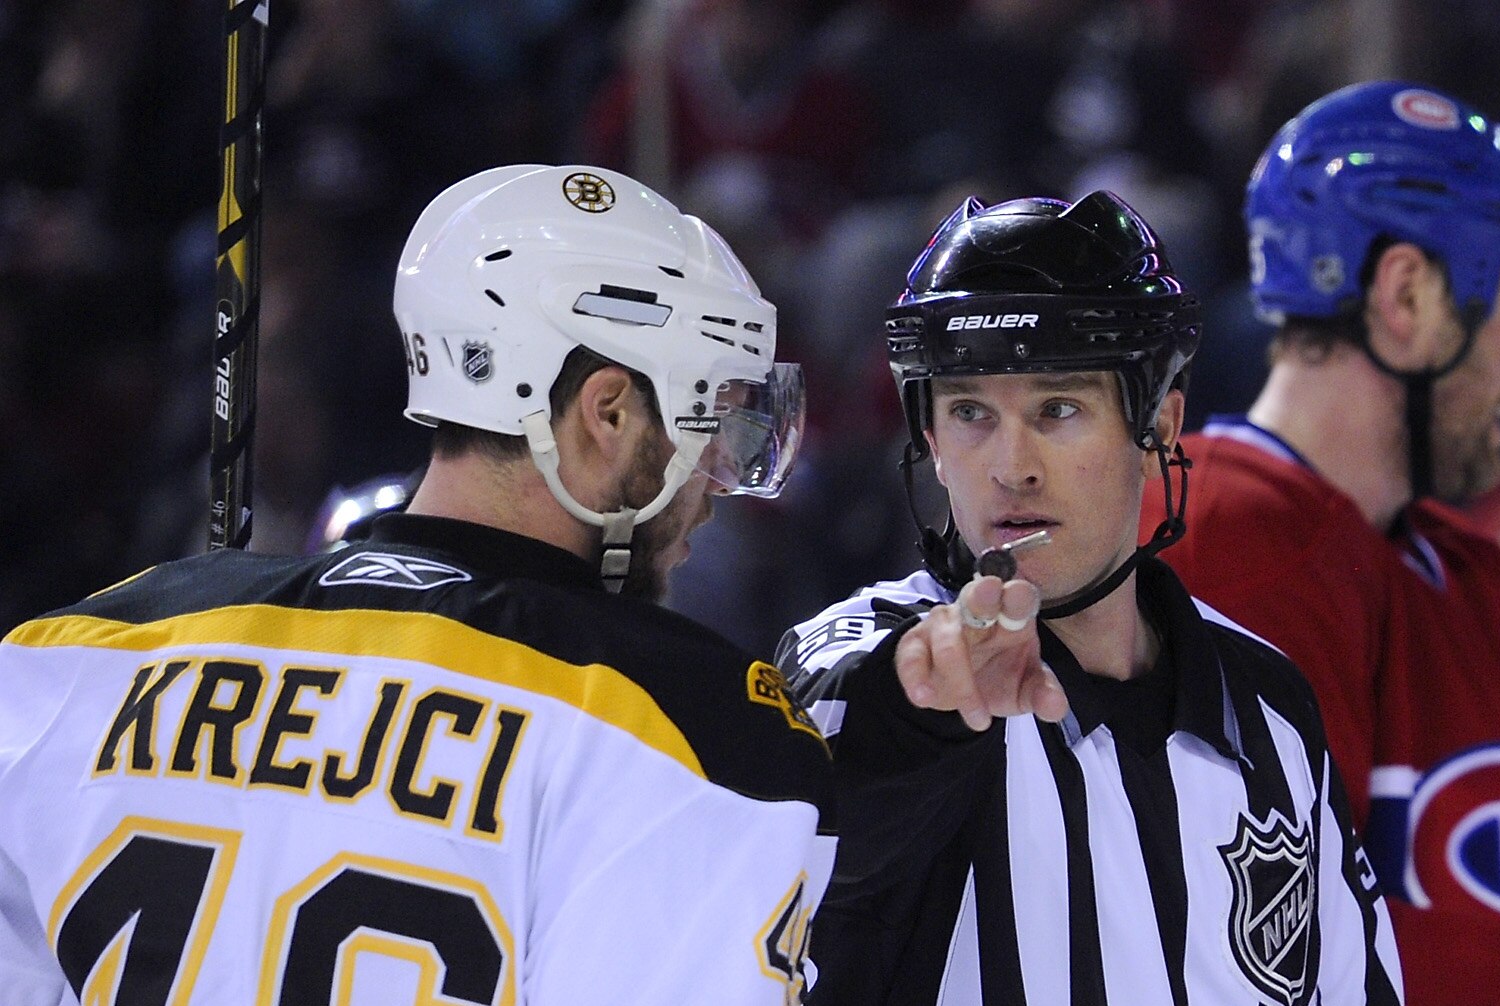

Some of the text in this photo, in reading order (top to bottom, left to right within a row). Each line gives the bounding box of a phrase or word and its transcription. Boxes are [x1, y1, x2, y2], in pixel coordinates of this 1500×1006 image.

[577, 180, 602, 203] B
[946, 313, 1039, 331] BAUER
[215, 310, 232, 421] BAUR
[797, 617, 876, 666] 59
[91, 656, 533, 843] KREJCI
[1261, 880, 1309, 962] NHL
